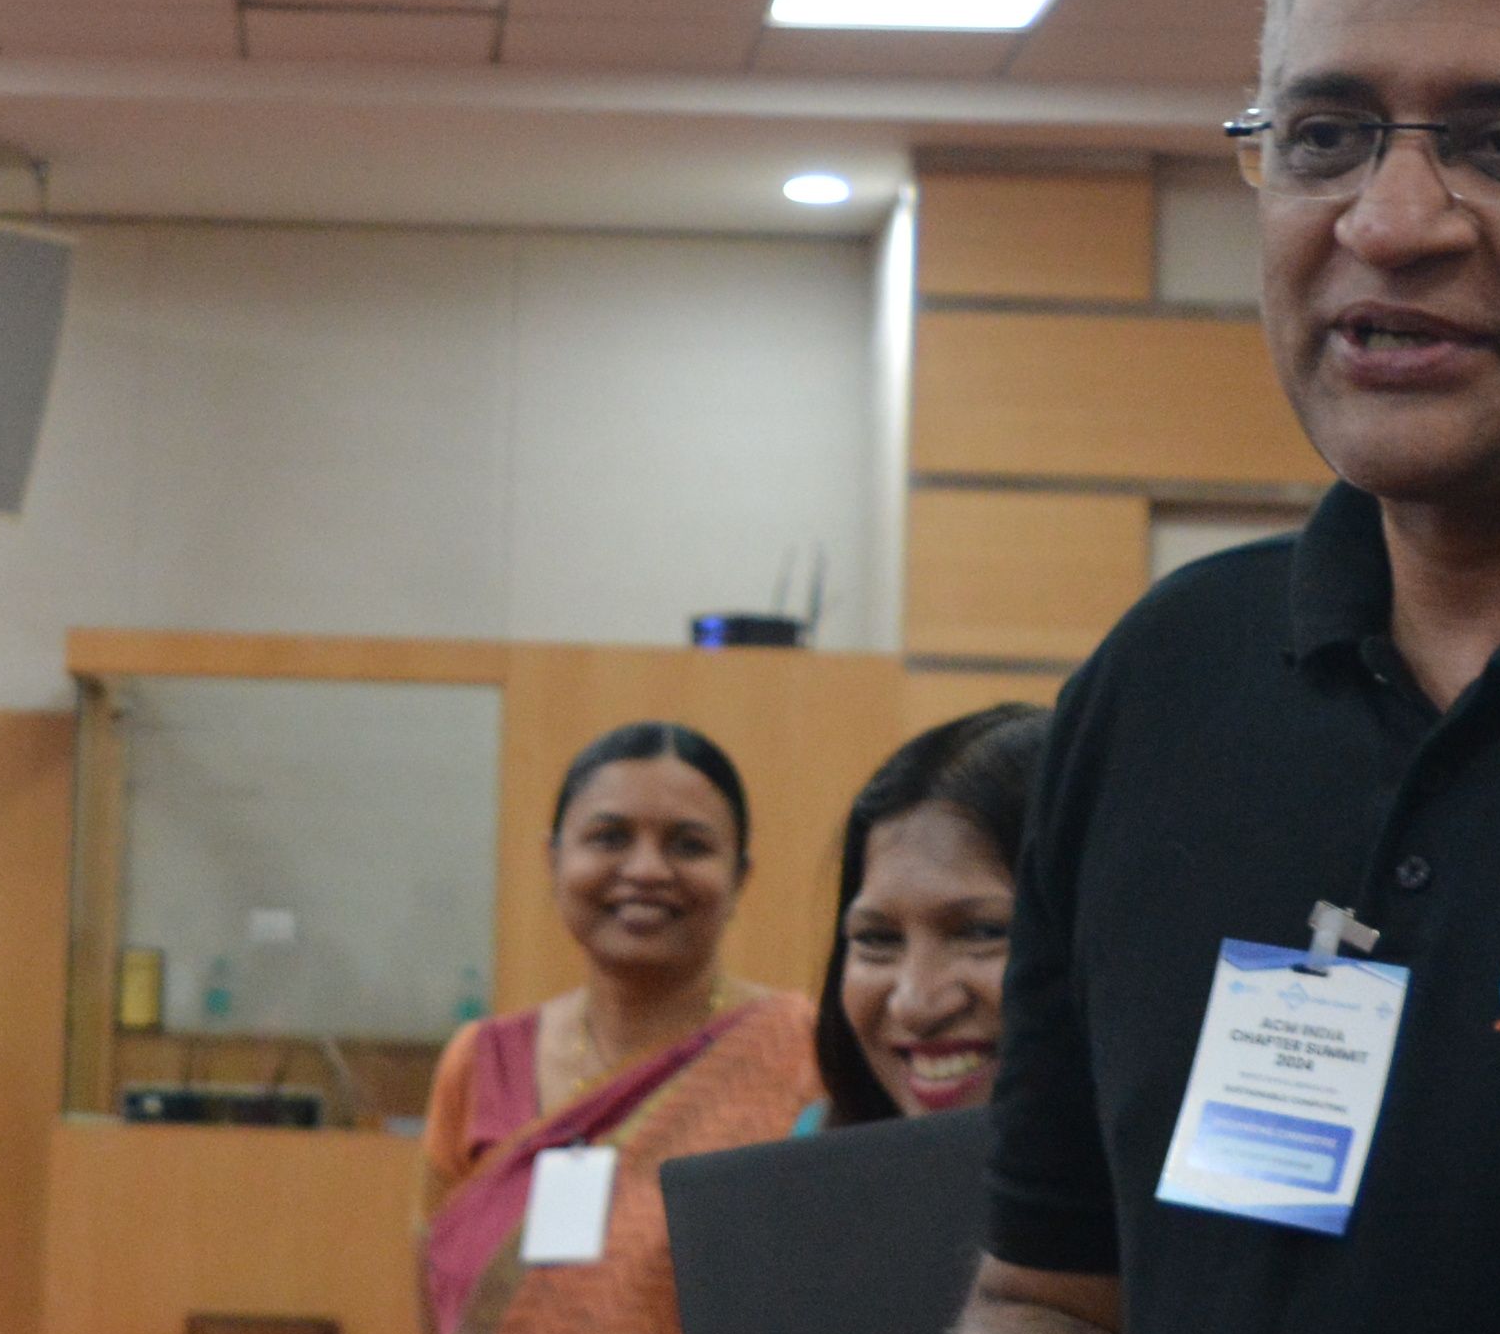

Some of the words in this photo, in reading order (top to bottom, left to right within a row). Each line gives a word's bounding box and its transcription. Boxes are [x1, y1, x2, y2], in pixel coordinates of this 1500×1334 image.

[1261, 1016, 1298, 1034] ACM
[1301, 1023, 1345, 1042] INDIA
[1229, 1028, 1301, 1052] CHAPTER
[1304, 1041, 1368, 1064] SUMMIT
[1275, 1052, 1314, 1071] 2024
